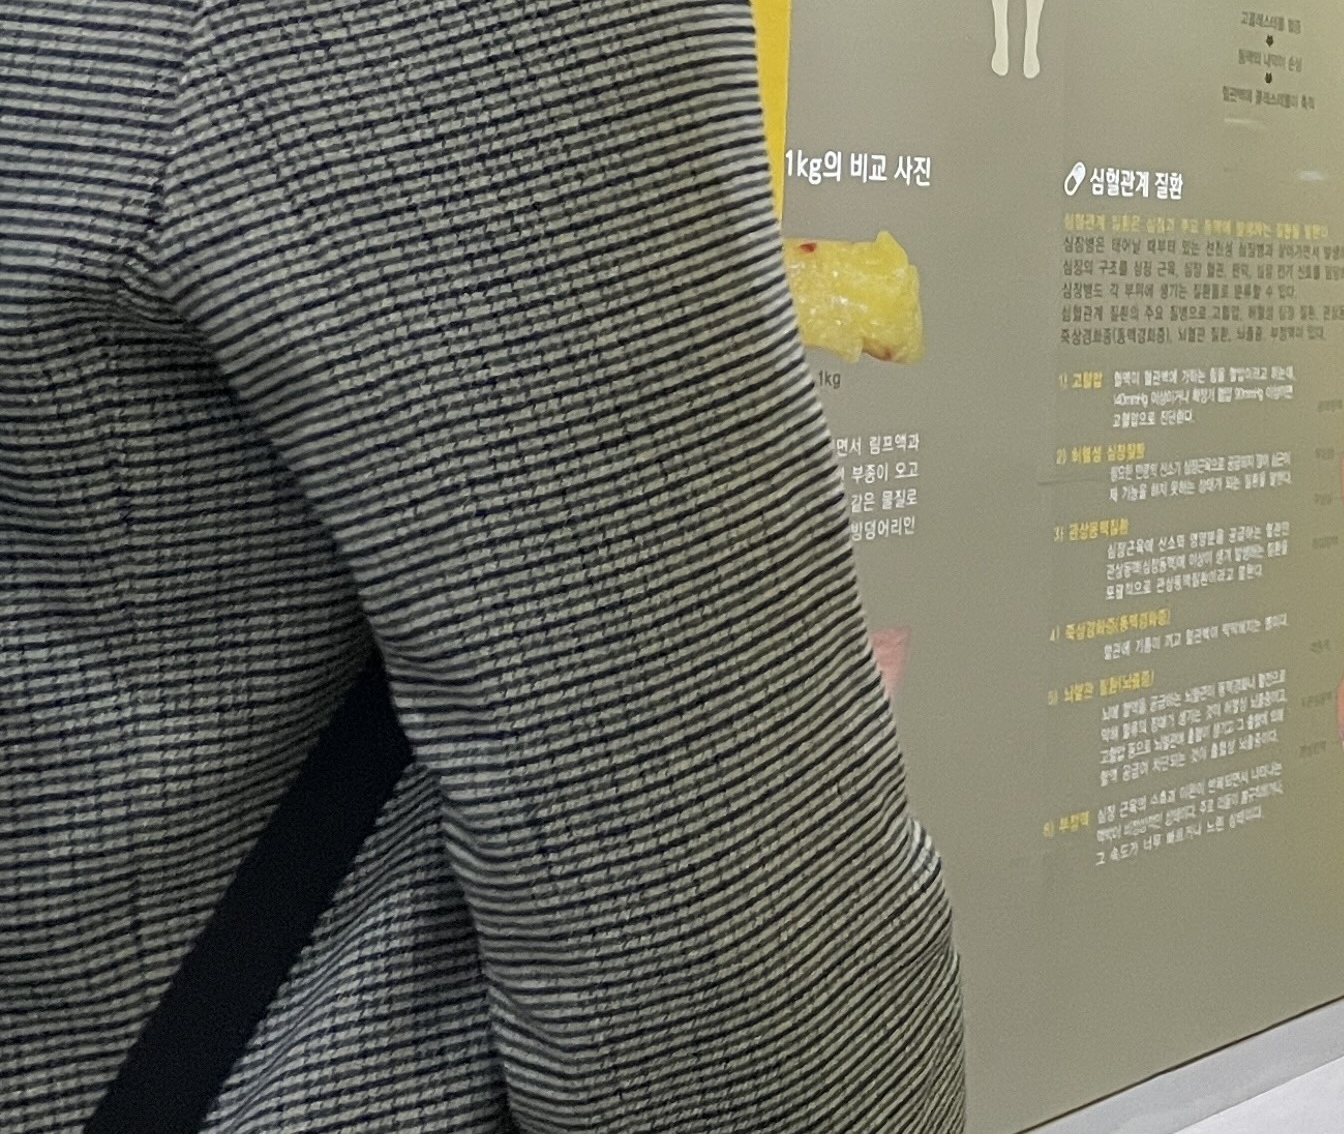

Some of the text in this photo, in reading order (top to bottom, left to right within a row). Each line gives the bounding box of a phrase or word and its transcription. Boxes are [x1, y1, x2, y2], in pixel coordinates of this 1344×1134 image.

[784, 149, 931, 187] 1kg의 비교 사진
[1090, 167, 1184, 201] 심혈관계 질환
[1065, 236, 1104, 253] 심장병은
[1112, 238, 1140, 254] 태어날
[1148, 239, 1175, 254] 때부터
[1063, 259, 1094, 276] 심장의
[1099, 260, 1128, 276] 구조를
[1134, 261, 1152, 277] 심장
[1063, 282, 1102, 299] 심장병도
[1109, 282, 1119, 299] 각
[1125, 283, 1153, 297] 부위에
[1161, 283, 1186, 299] 생기는
[1061, 305, 1103, 322] 심혈관계
[1145, 305, 1163, 321] 주요
[1170, 305, 1206, 321] 질병으로
[1179, 327, 1204, 343] 뇌혈관
[818, 369, 841, 389] 1kg
[1072, 371, 1103, 389] 고혈압
[1112, 411, 1155, 428] 고혈압으로
[869, 433, 920, 456] 림프액과
[1072, 446, 1102, 463] 허혈성
[1108, 443, 1145, 461] 심장질환
[851, 462, 919, 484] 부종이 오고
[850, 488, 918, 514] 같은 물질로
[1108, 539, 1153, 559] 심장근육에
[1098, 805, 1116, 824] 심장
[1110, 842, 1139, 860] 속도가
[1143, 834, 1161, 850] 너무
